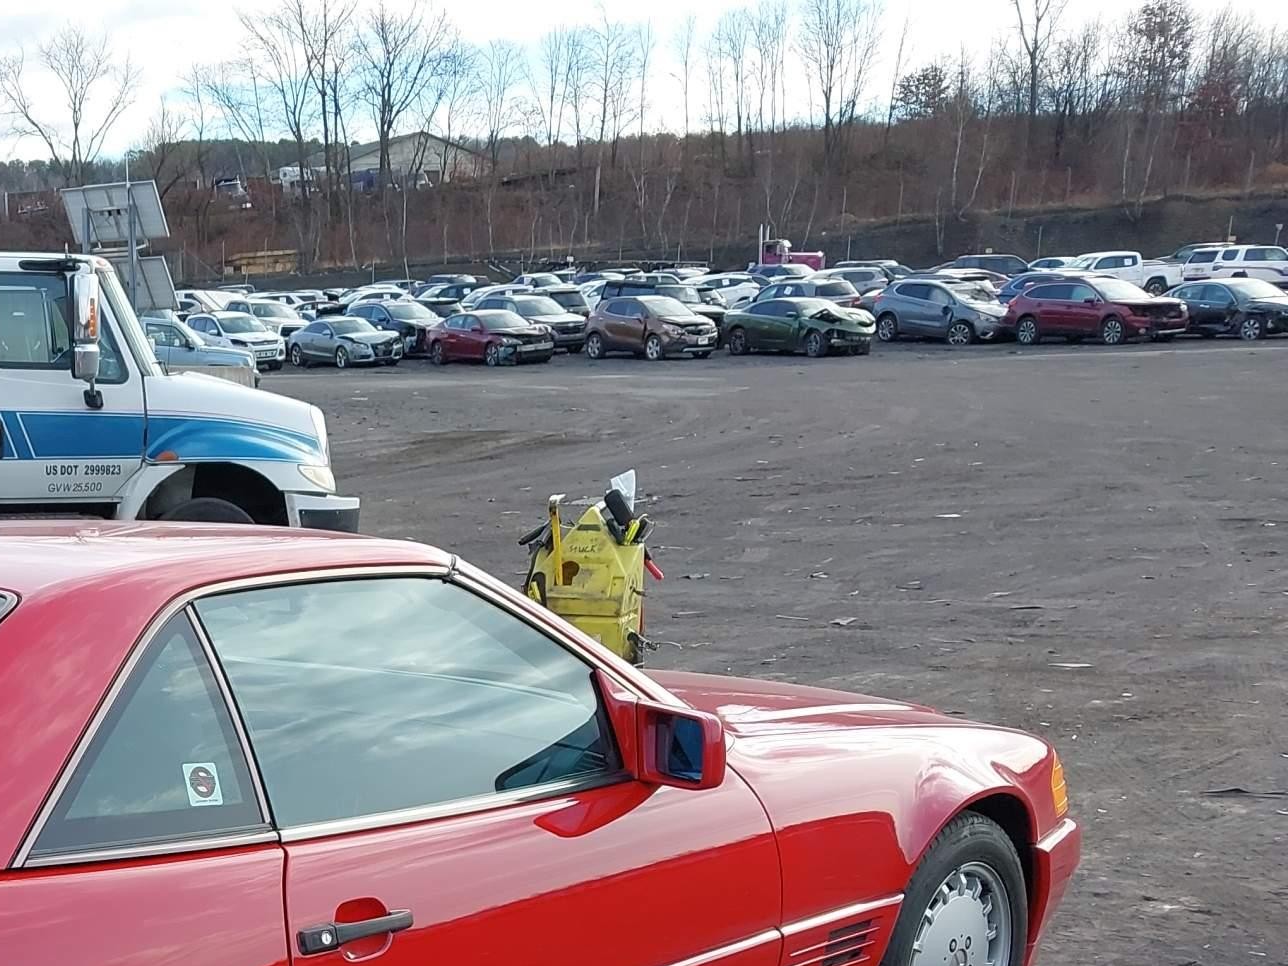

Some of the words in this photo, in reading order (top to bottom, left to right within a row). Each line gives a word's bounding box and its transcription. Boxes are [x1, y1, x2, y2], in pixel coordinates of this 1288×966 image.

[45, 464, 58, 476] US
[60, 464, 79, 476] DOT
[84, 464, 121, 476] 2999823
